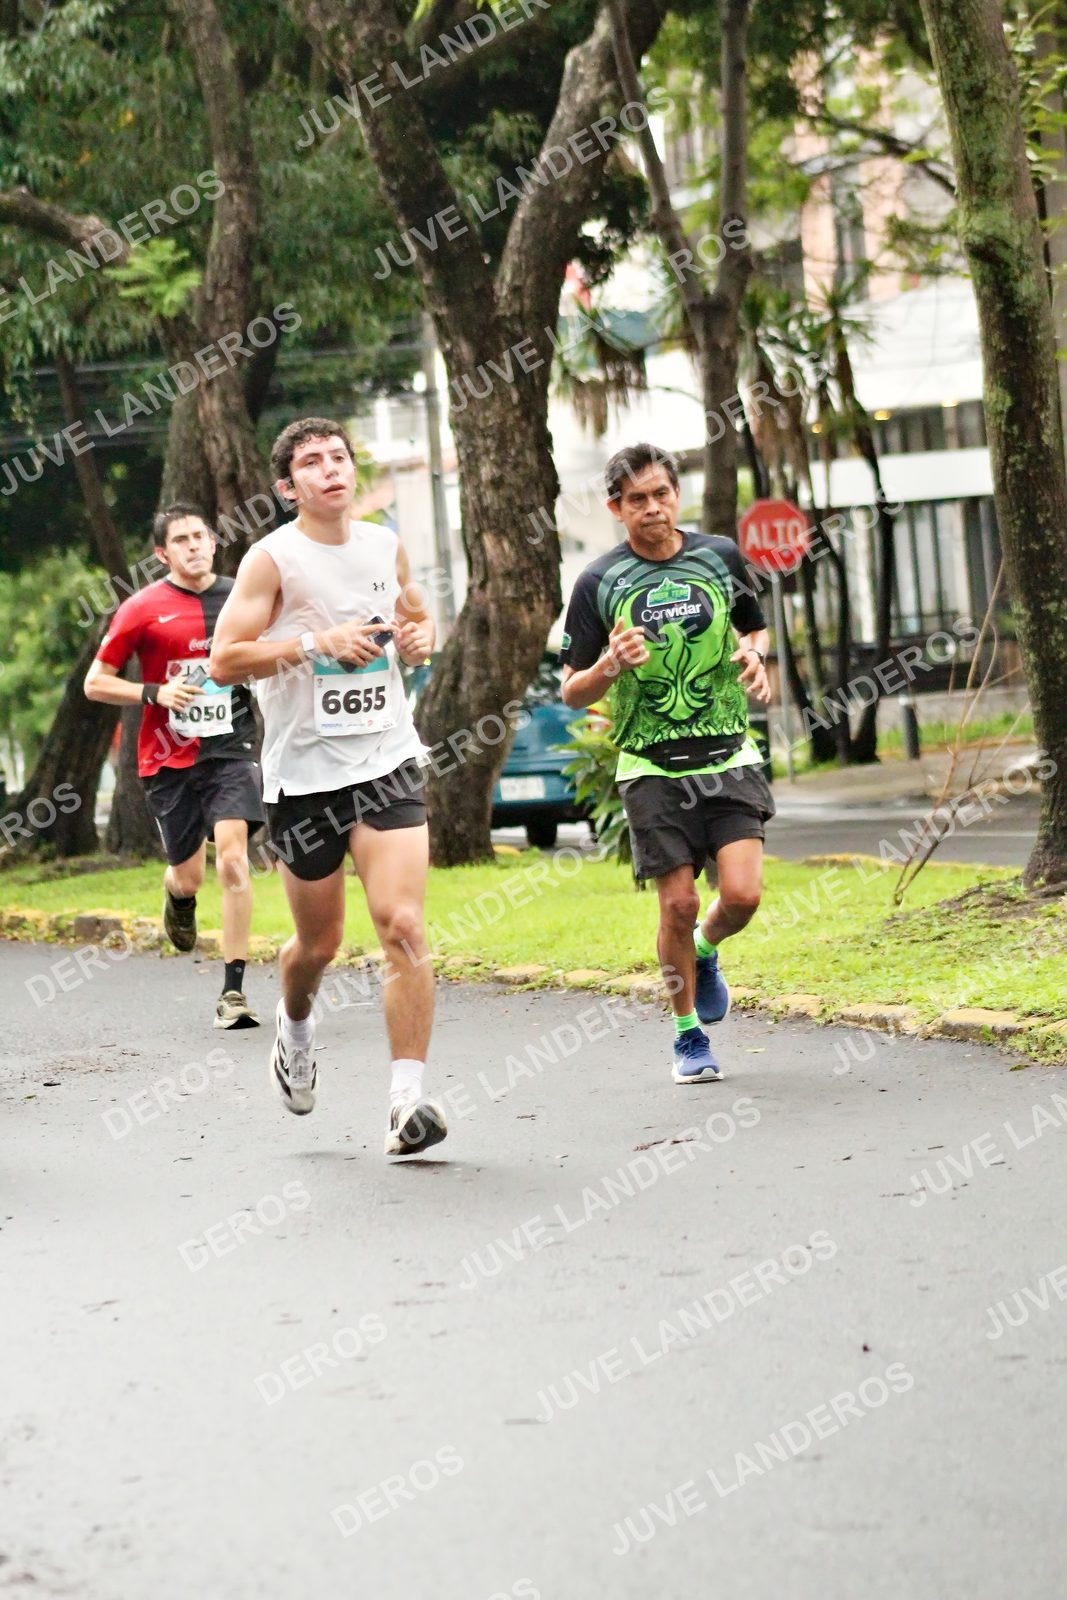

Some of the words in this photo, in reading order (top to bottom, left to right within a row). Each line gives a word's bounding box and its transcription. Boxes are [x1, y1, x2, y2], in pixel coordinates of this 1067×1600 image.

[745, 518, 803, 551] ALTO
[641, 603, 702, 622] Convidar
[322, 685, 386, 715] 6655
